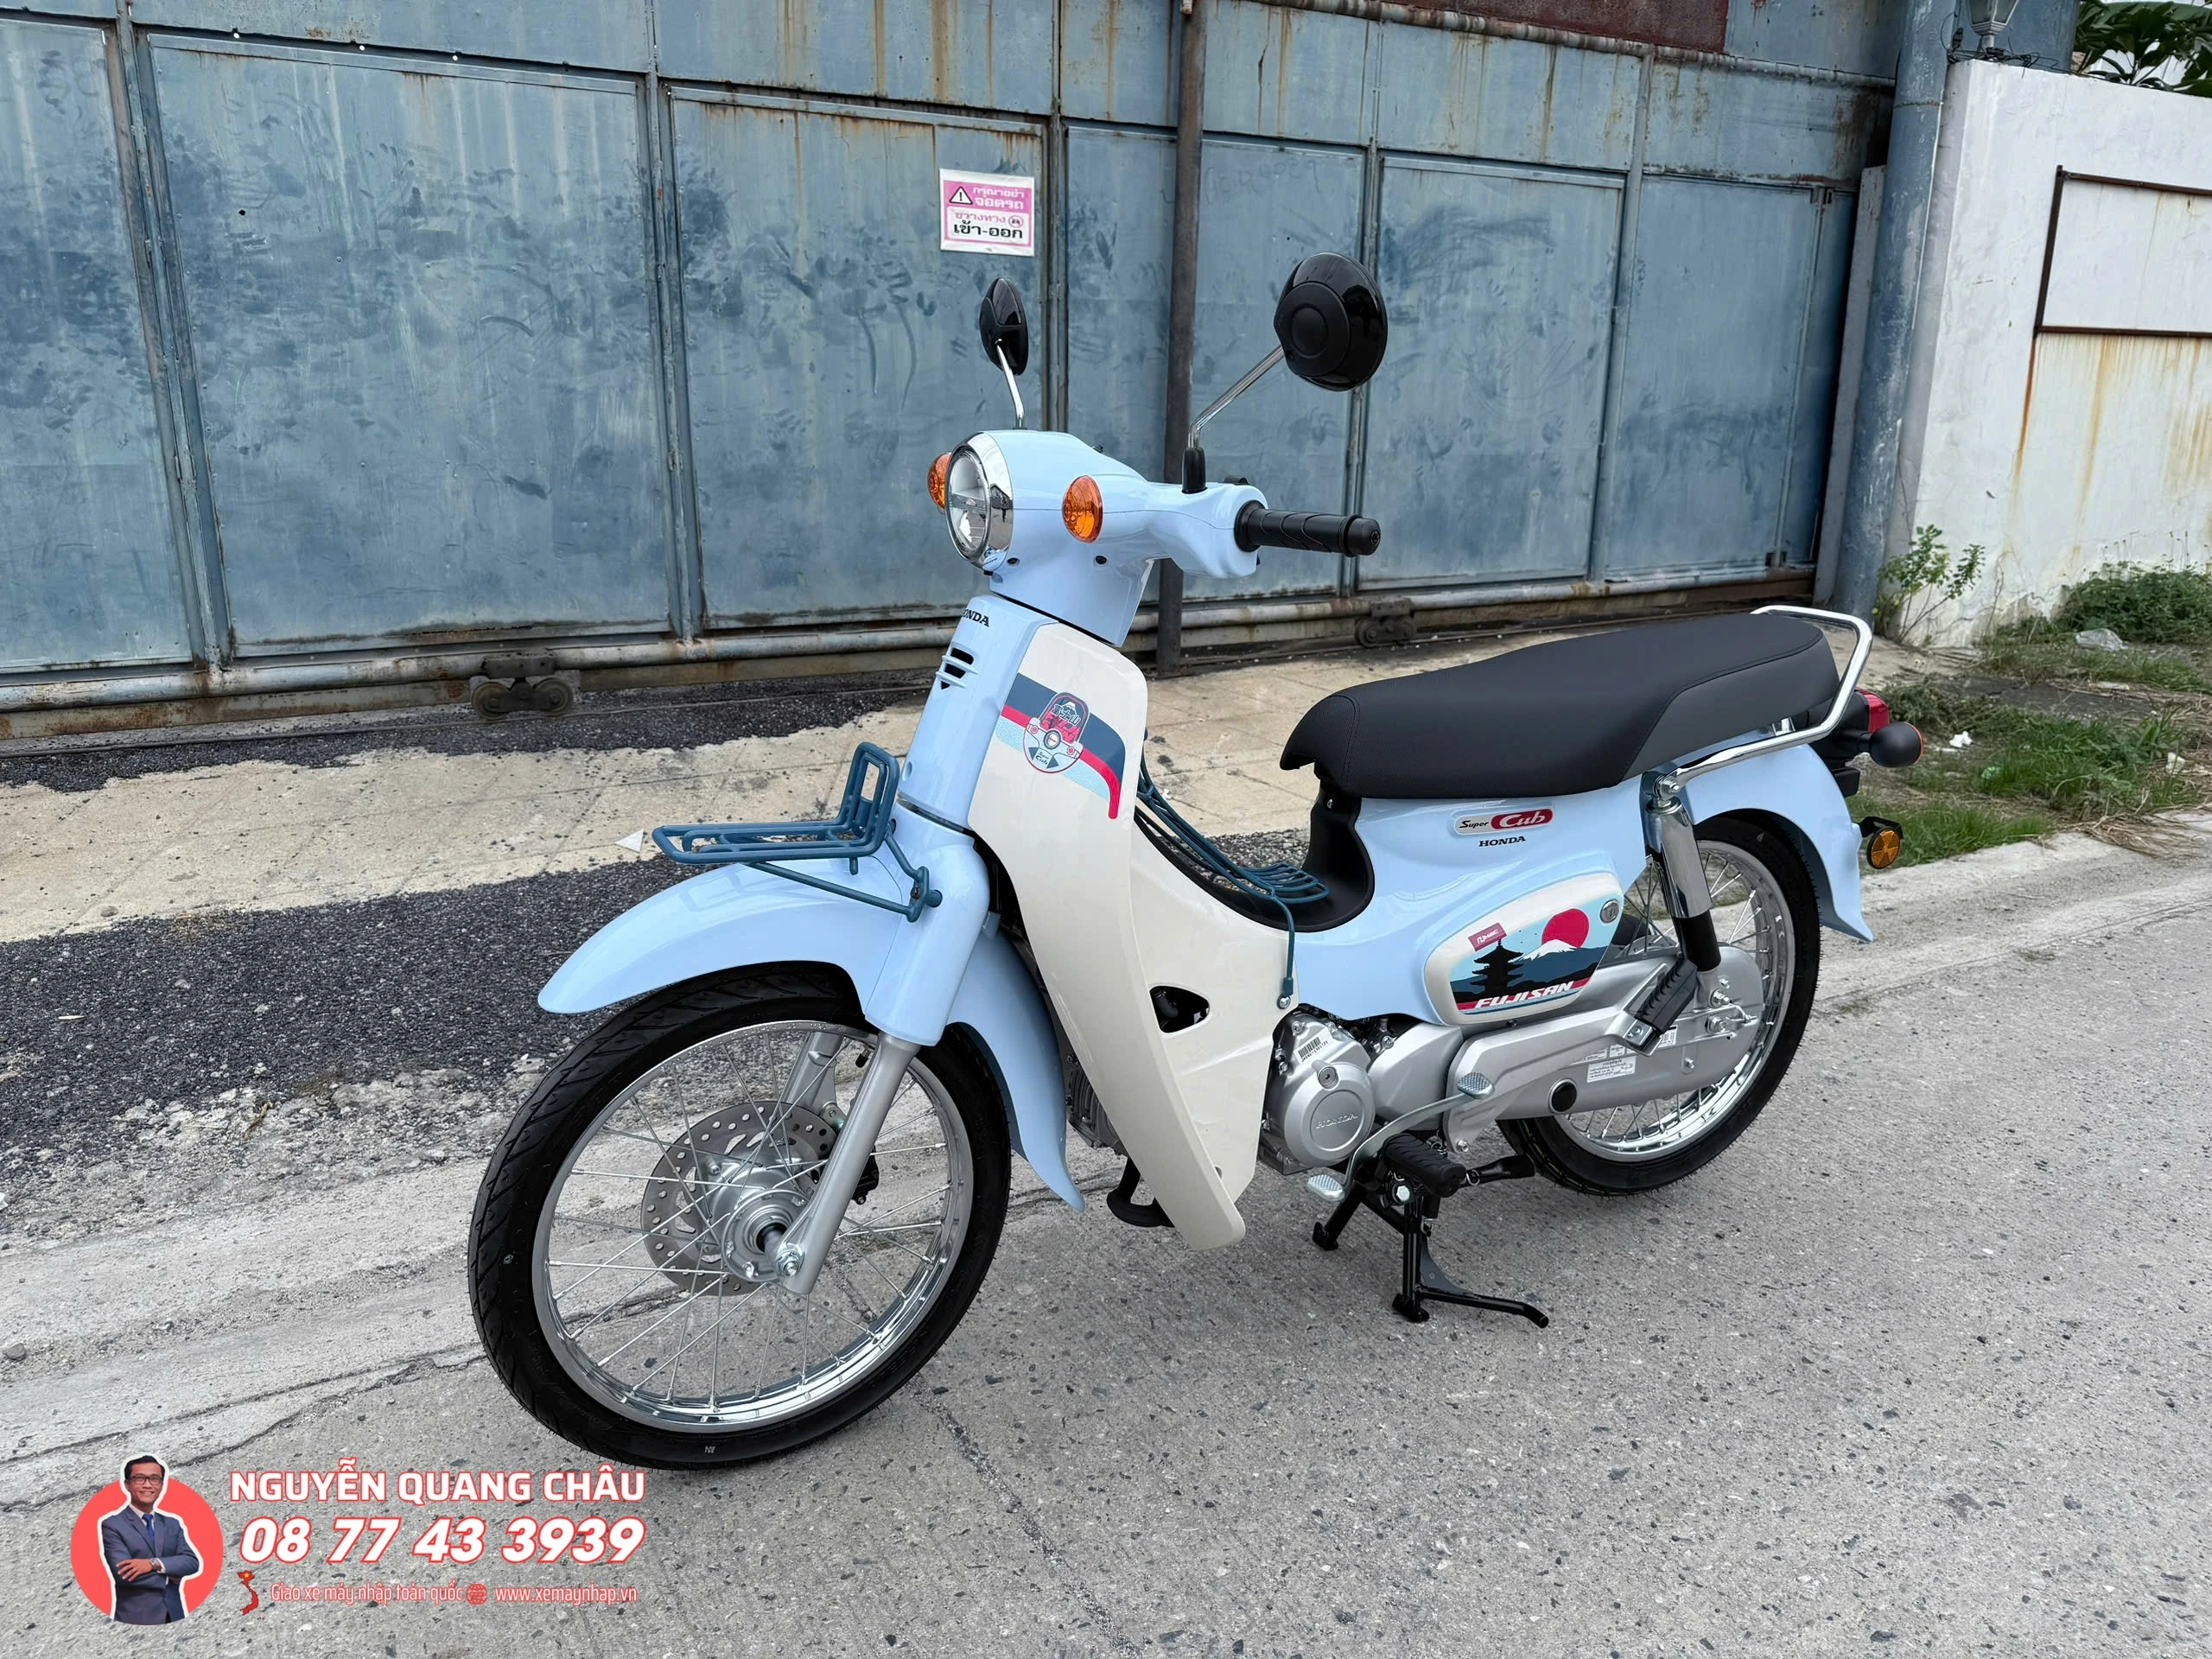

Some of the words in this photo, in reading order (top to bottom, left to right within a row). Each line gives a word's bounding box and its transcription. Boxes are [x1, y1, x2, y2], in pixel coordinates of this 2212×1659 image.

[975, 196, 1024, 209] จอดรถ
[954, 219, 1023, 238] เข้า-ออก
[1459, 820, 1490, 829] Super
[1499, 810, 1545, 828] Cub
[1478, 836, 1526, 847] HONDA
[1474, 981, 1574, 1009] FUJISAN
